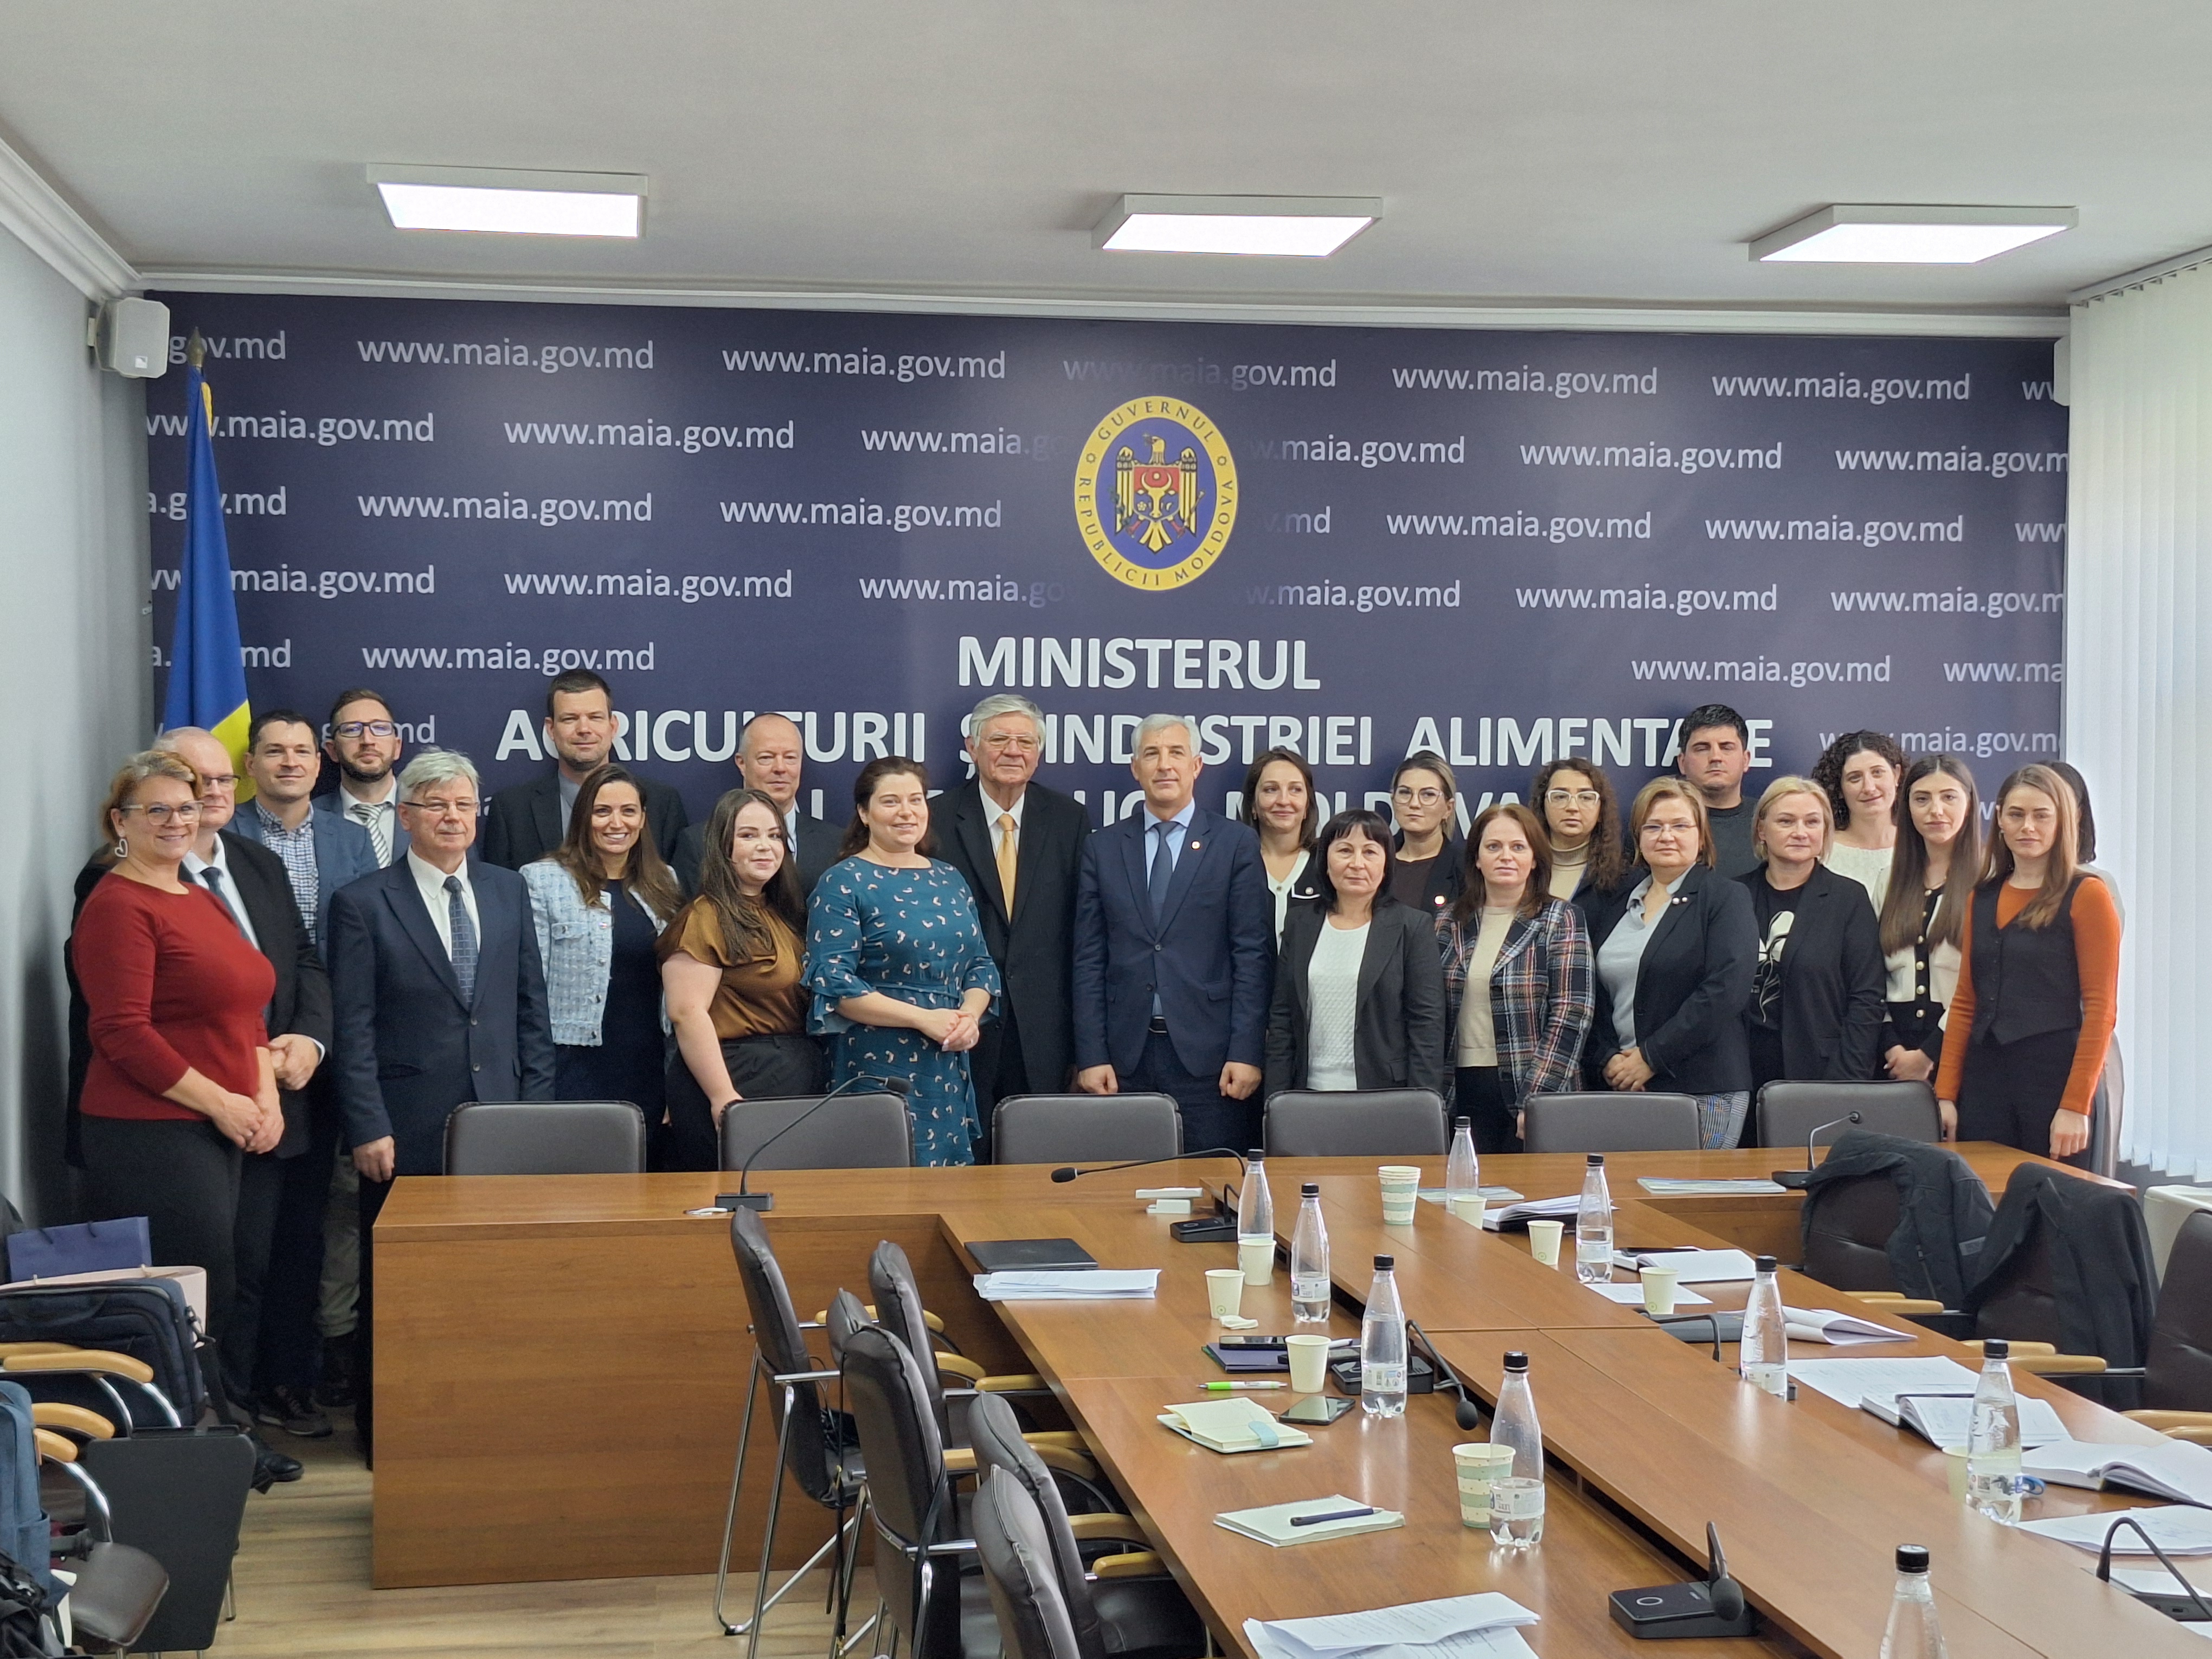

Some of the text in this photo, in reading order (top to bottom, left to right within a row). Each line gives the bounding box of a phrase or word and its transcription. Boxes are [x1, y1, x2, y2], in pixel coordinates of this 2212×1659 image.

[357, 338, 654, 374] www.maia.gov.md
[722, 347, 1006, 383] www.maia.gov.md
[1392, 365, 1658, 399] www.maia.gov.md
[1711, 371, 1970, 406] www.maia.gov.md
[503, 418, 795, 454] www.maia.gov.md
[1097, 401, 1214, 442] GUVERNUL
[1520, 441, 1783, 475] www.maia.gov.md
[357, 491, 652, 527] www.maia.gov.md
[719, 497, 1001, 532] www.maia.gov.md
[1386, 510, 1651, 544] www.maia.gov.md
[1078, 477, 1159, 586] REPUBLICII
[1174, 479, 1233, 582] MOLDOVA
[1705, 514, 1964, 548] www.maia.gov.md
[503, 568, 792, 603] www.maia.gov.md
[1515, 583, 1777, 616] www.maia.gov.md
[361, 641, 655, 677] www.maia.gov.md
[958, 635, 1321, 690] MINISTERUL
[1631, 655, 1891, 688] www.maia.gov.md
[1045, 714, 1372, 766] INDSTRIEI
